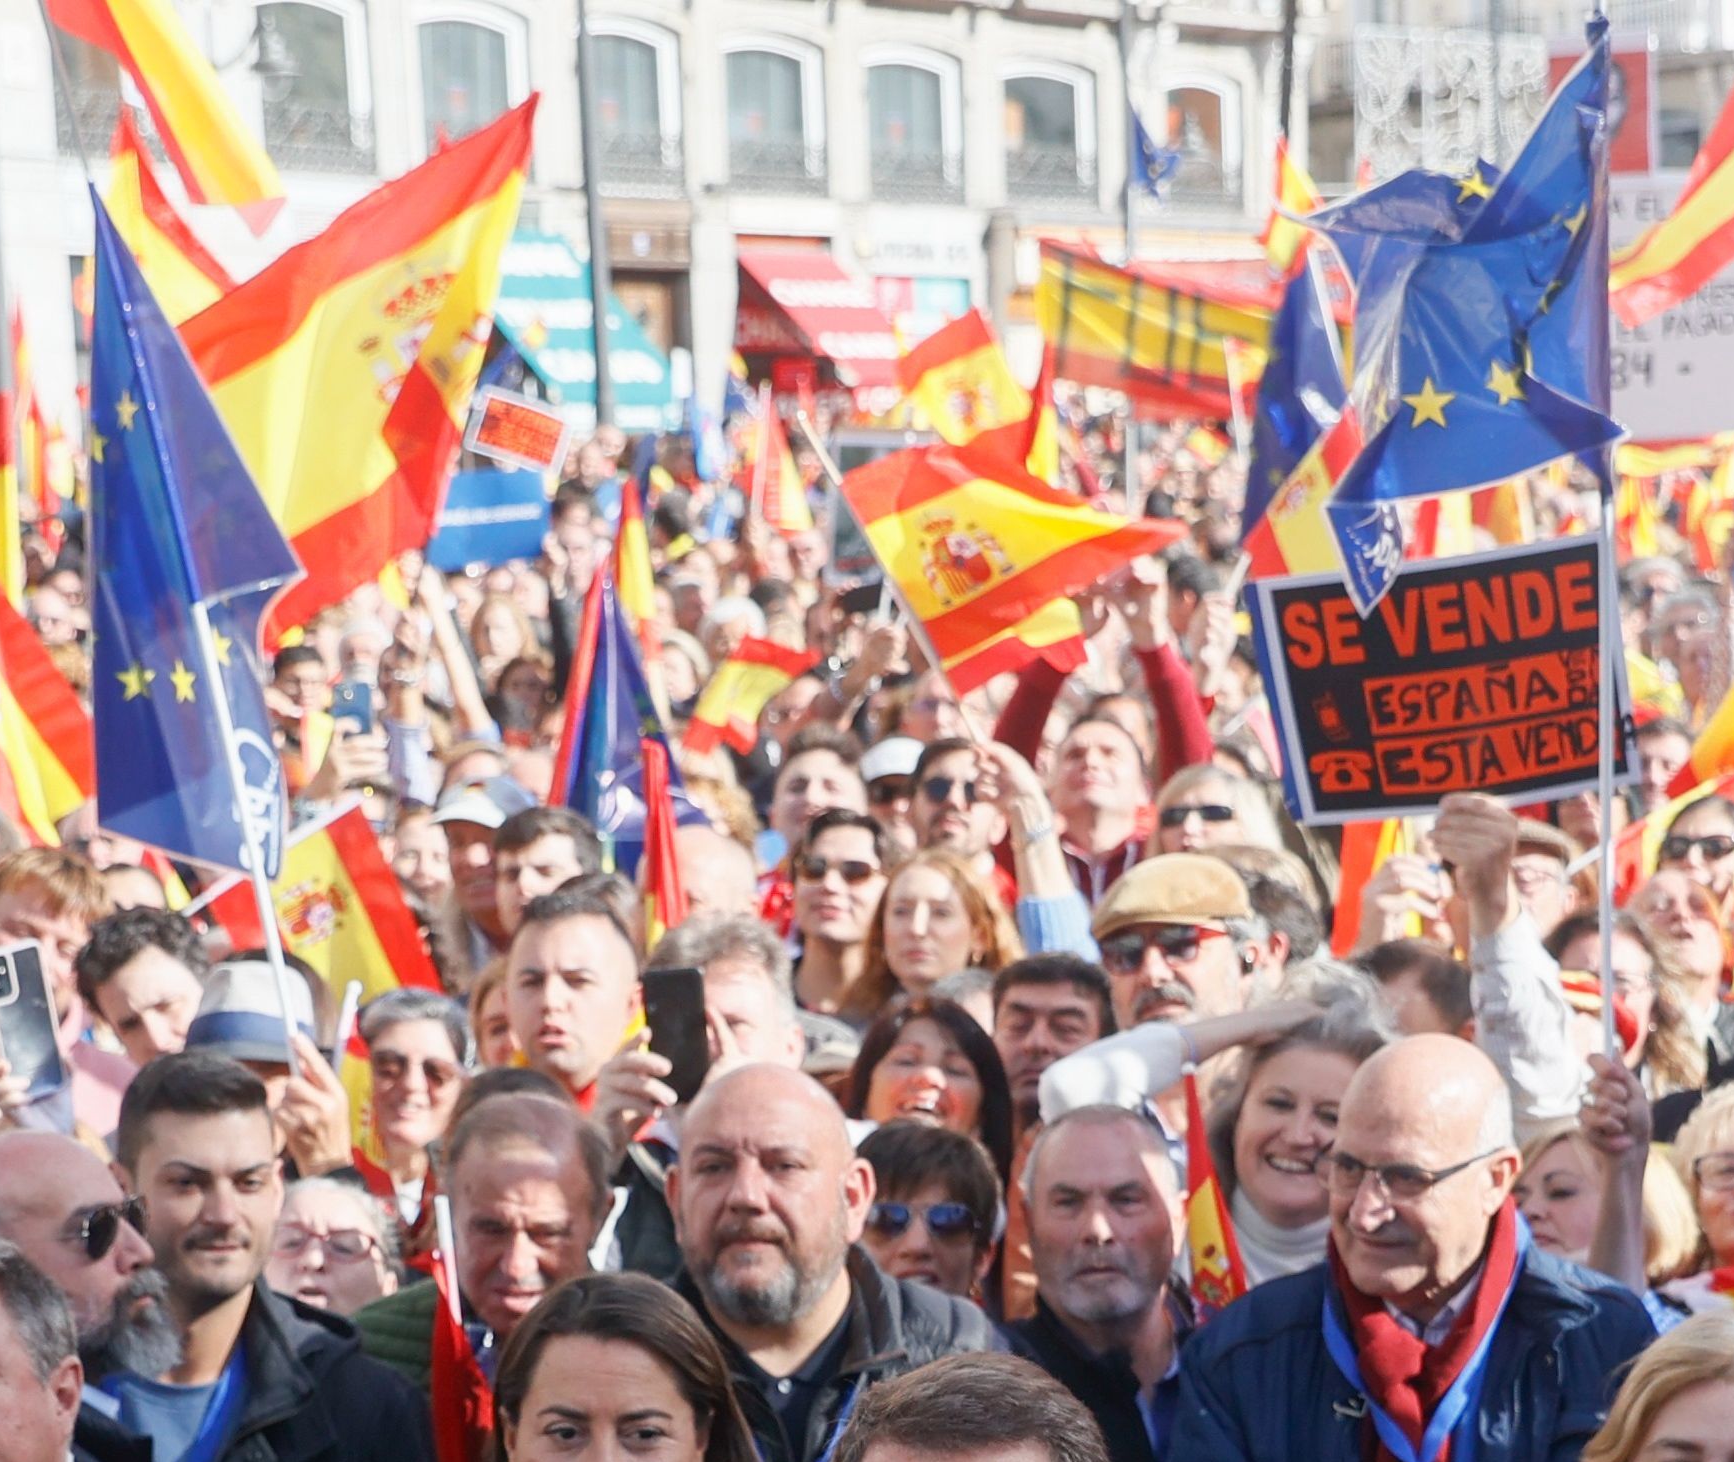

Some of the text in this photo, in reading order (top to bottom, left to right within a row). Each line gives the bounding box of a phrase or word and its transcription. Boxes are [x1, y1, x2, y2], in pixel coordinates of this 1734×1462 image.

[1282, 598, 1365, 669] SE
[1377, 560, 1598, 658] VENDE
[1369, 662, 1559, 727] ESPAÑA
[1381, 732, 1506, 786] ESTA
